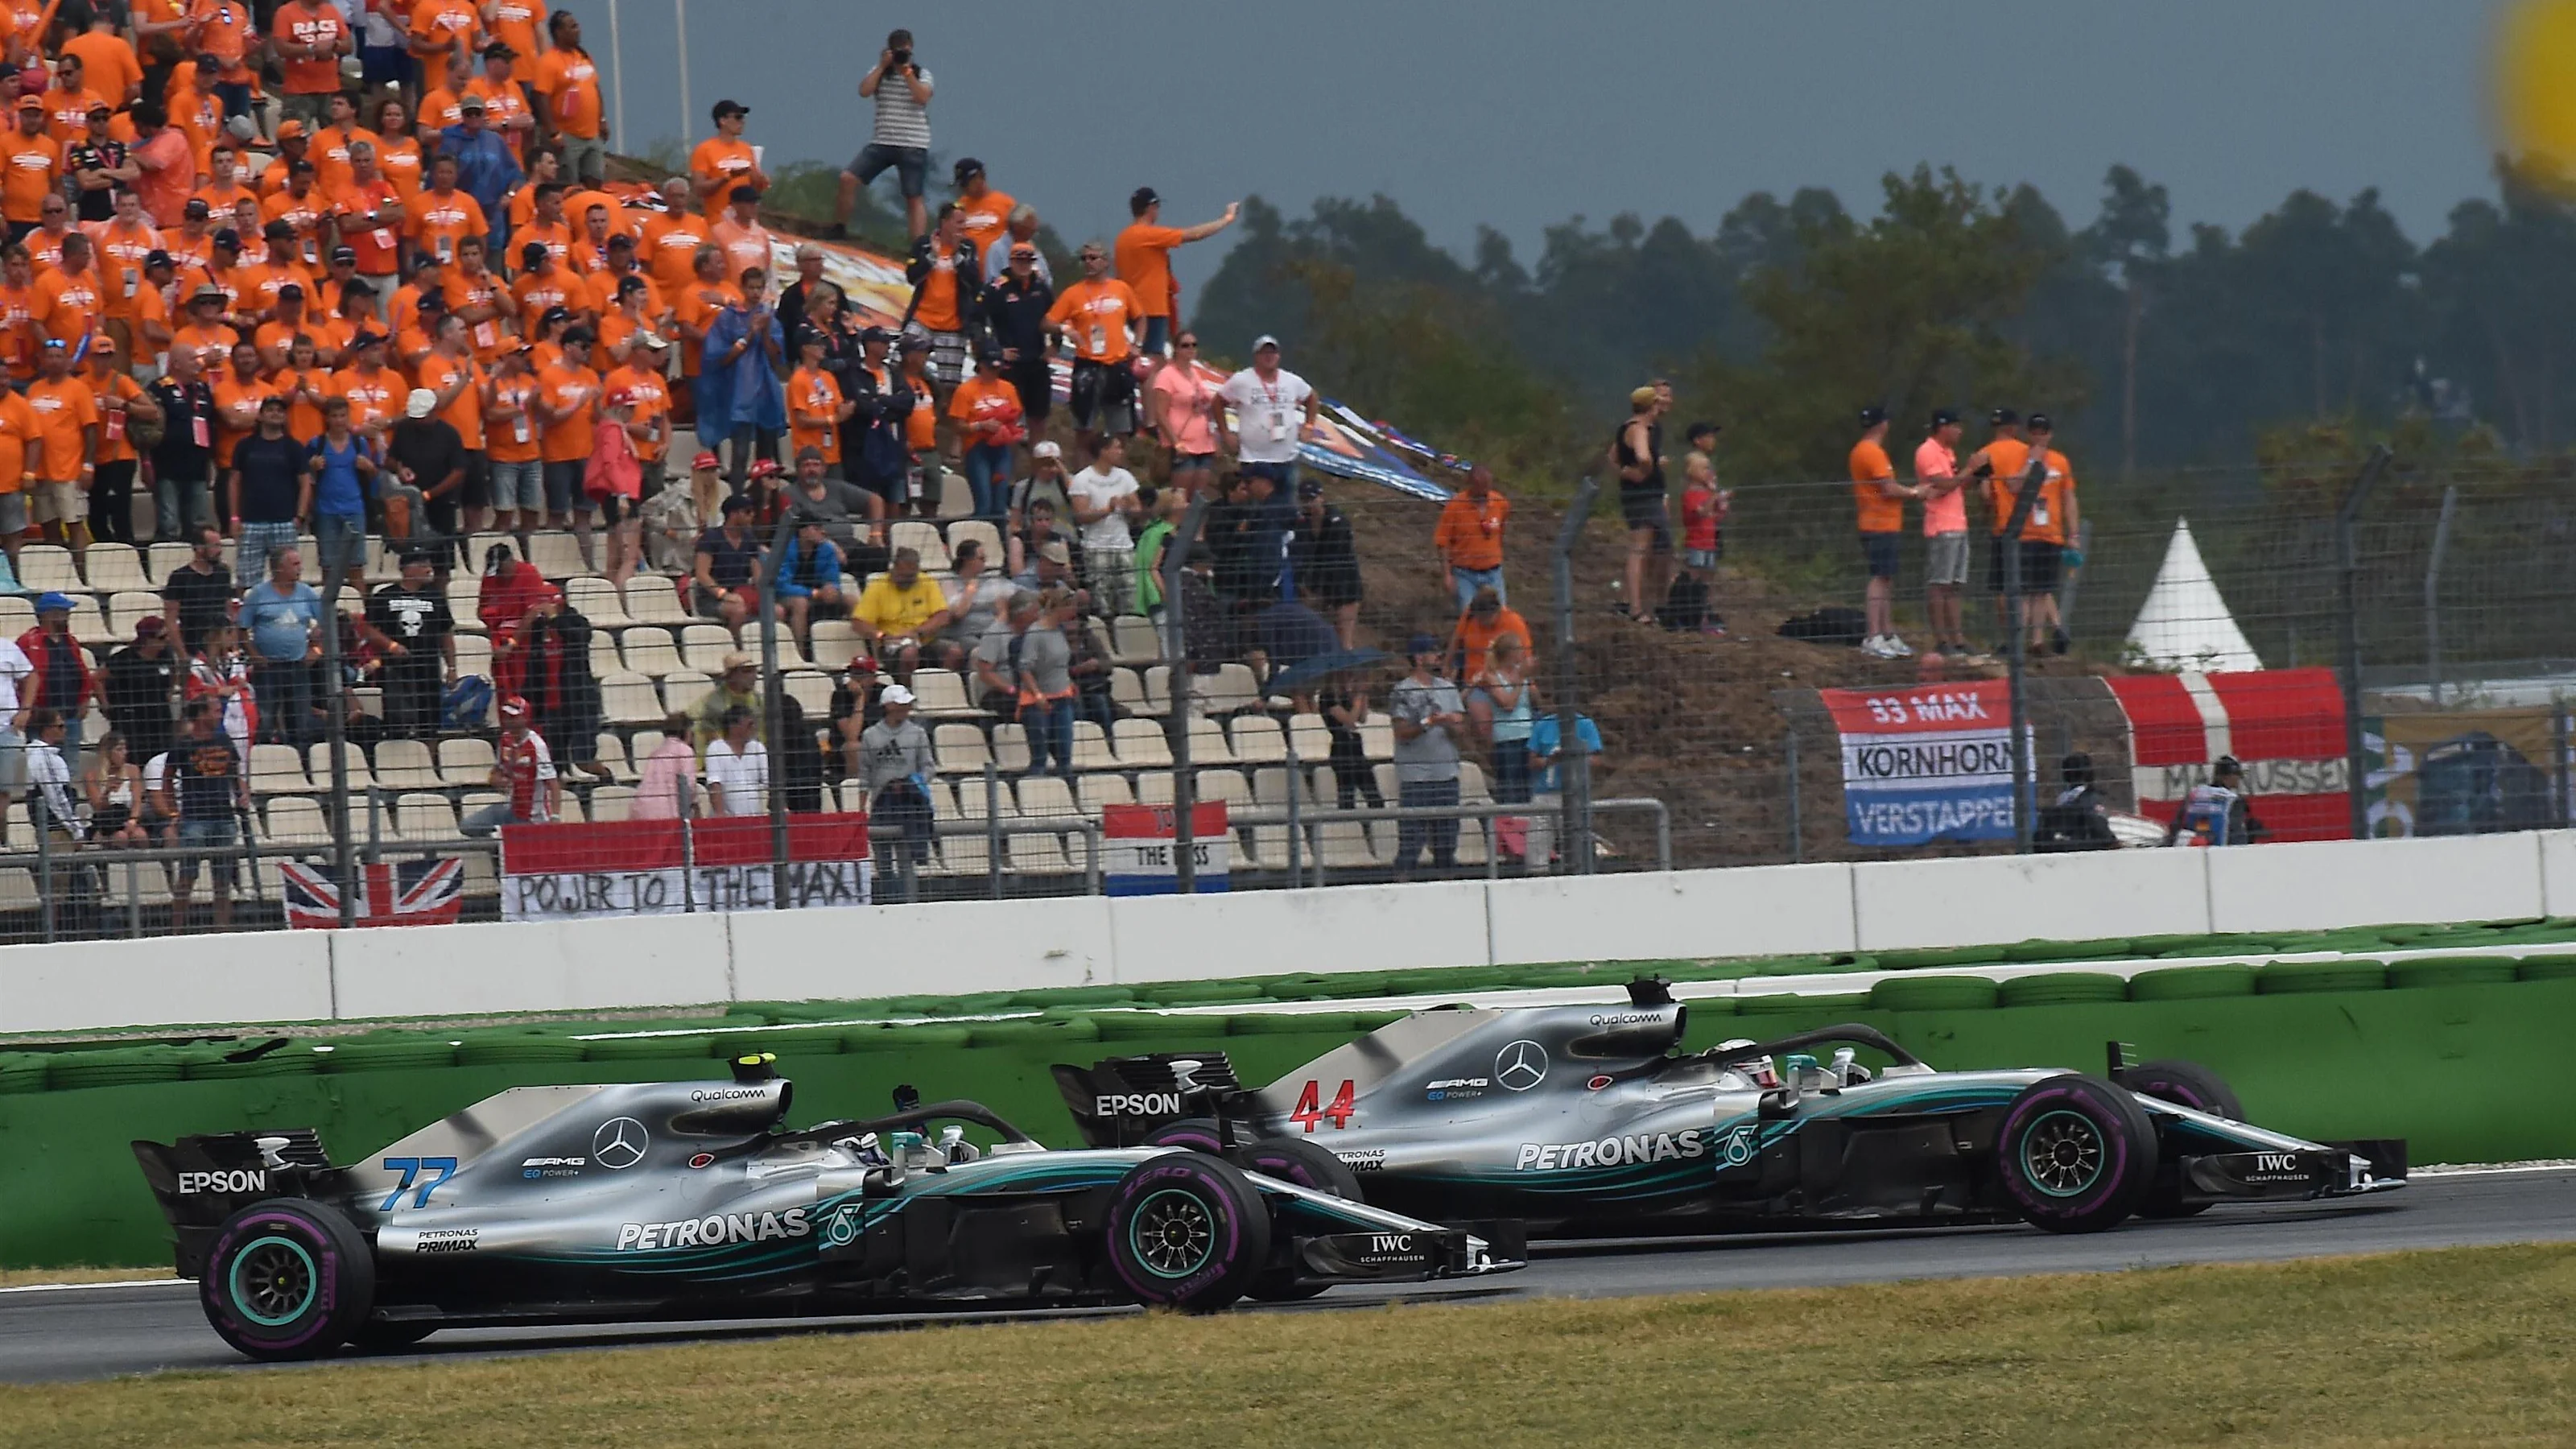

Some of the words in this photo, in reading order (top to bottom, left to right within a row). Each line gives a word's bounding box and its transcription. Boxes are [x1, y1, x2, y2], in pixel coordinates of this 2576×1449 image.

[1868, 698, 1907, 723] 33
[1910, 693, 1988, 722] MAX
[1855, 796, 2014, 834] VERSTAPPE
[1136, 847, 1167, 865] THE
[518, 873, 617, 911] POWER
[623, 873, 673, 911] TO
[700, 865, 770, 911] THE
[1589, 1013, 1662, 1027] Qualcomm
[691, 1088, 766, 1103] Qualcomm
[1096, 1092, 1180, 1117] EPSON
[1290, 1080, 1355, 1133] 44
[1516, 1129, 1705, 1171] PETRONAS
[543, 1158, 585, 1166] AMG
[2256, 1154, 2297, 1171] IWC
[179, 1170, 266, 1194] EPSON
[523, 1169, 542, 1179] EQ
[2245, 1174, 2310, 1183] SCHAFFHAUSEN
[378, 1157, 457, 1211] 77
[419, 1228, 479, 1240] PETRONAS
[617, 1208, 810, 1251] PETRONAS
[415, 1240, 478, 1253] PRIMAX
[1372, 1235, 1412, 1253] IWC
[1360, 1254, 1425, 1263] SCHAFFHAUSEN
